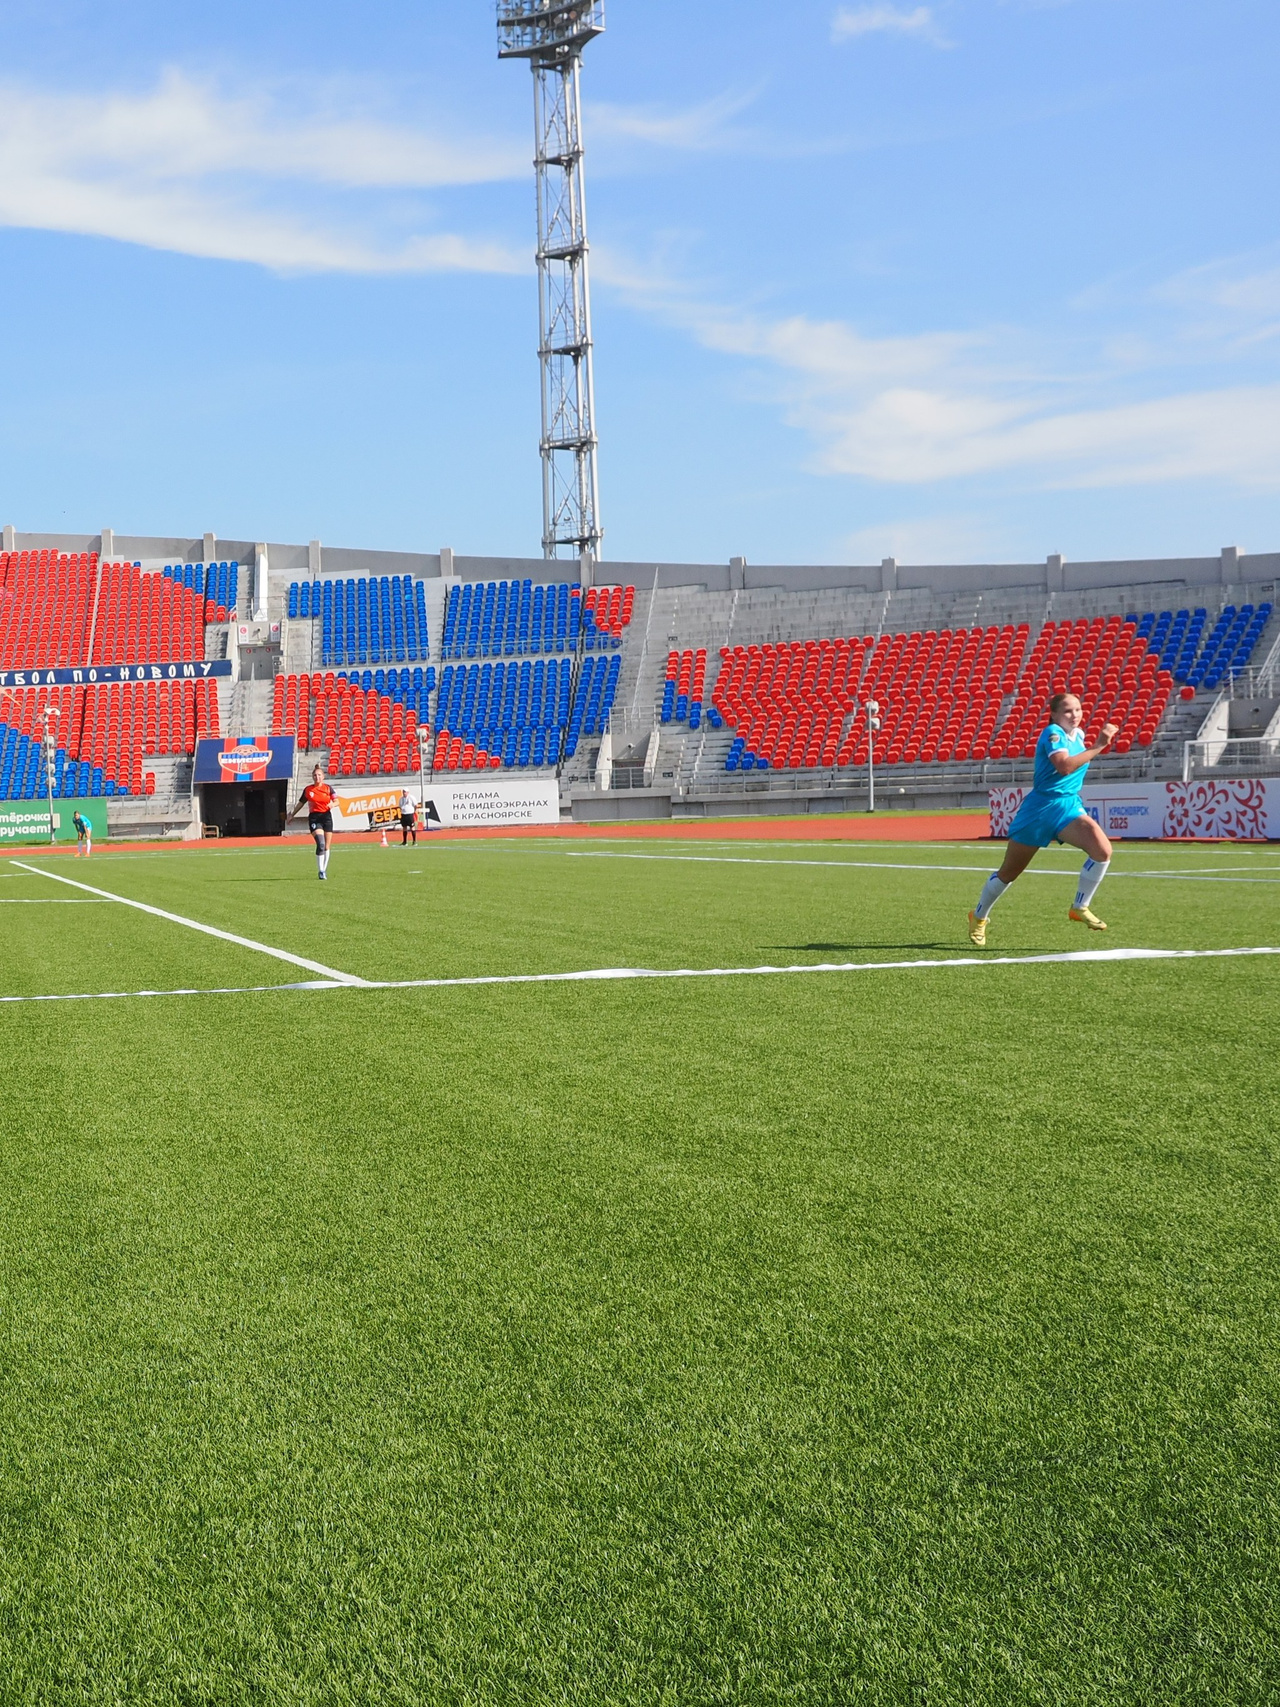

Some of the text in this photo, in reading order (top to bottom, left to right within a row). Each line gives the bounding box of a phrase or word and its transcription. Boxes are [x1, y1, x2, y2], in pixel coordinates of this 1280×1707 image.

[73, 662, 212, 683] ПО-НОВОМУ
[452, 791, 500, 800] РЕКЛАМА
[346, 795, 397, 814] МЕДИА
[469, 799, 548, 810] ВИДЕОЭКРАНАХ
[462, 810, 533, 820] КРАСНОЯРСКЕ
[1109, 817, 1128, 829] 2025
